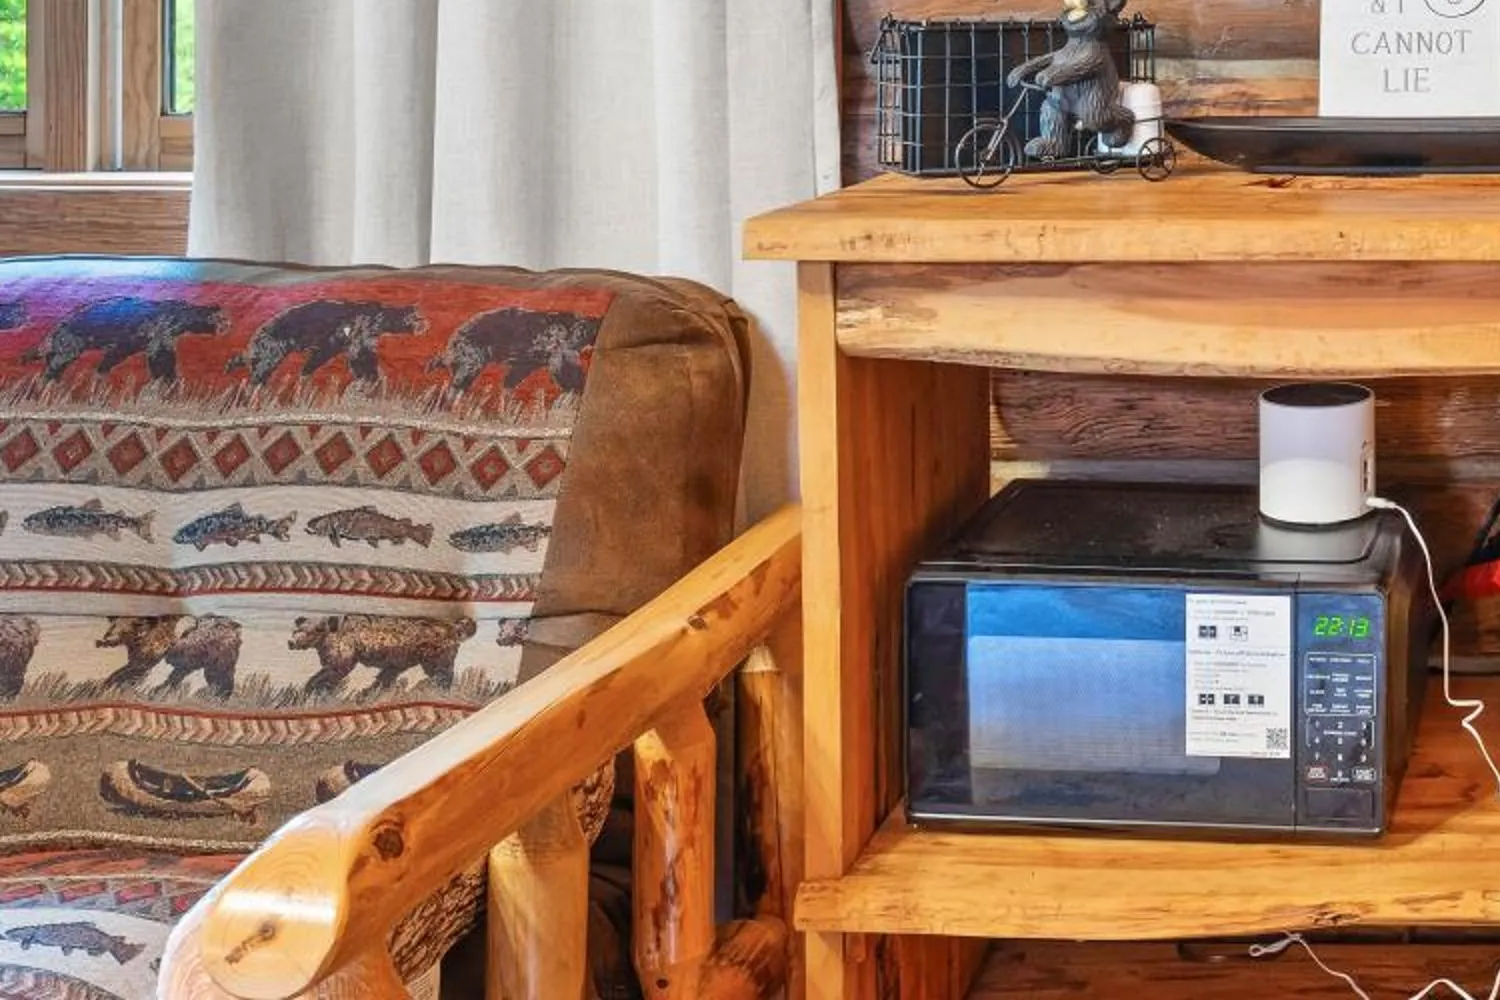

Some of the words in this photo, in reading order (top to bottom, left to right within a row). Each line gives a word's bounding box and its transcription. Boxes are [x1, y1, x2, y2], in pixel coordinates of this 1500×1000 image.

[1351, 29, 1474, 56] CANNOT
[1383, 66, 1432, 94] LIE
[1314, 616, 1370, 638] 22:13
